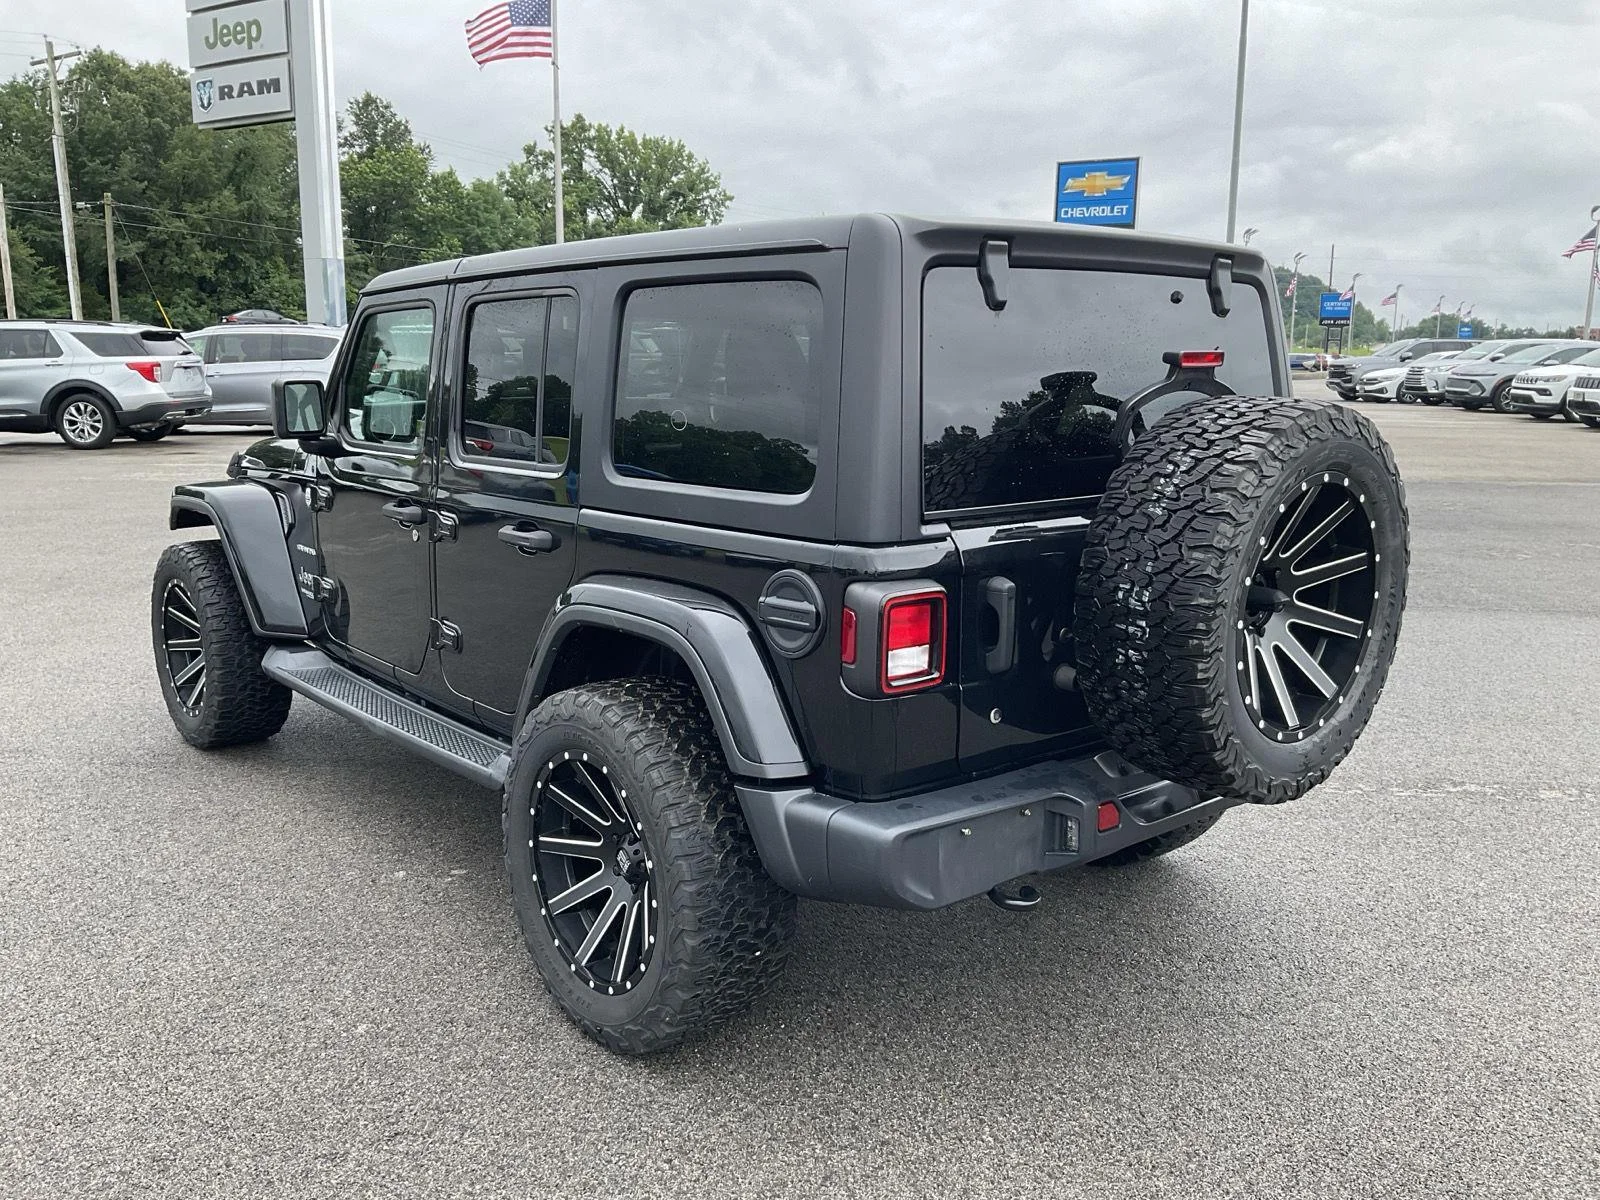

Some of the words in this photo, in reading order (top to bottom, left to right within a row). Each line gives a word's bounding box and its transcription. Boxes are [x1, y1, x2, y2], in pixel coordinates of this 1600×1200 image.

[204, 17, 262, 50] Jeep
[218, 77, 281, 101] RAM
[1060, 205, 1129, 218] CHEVROLET
